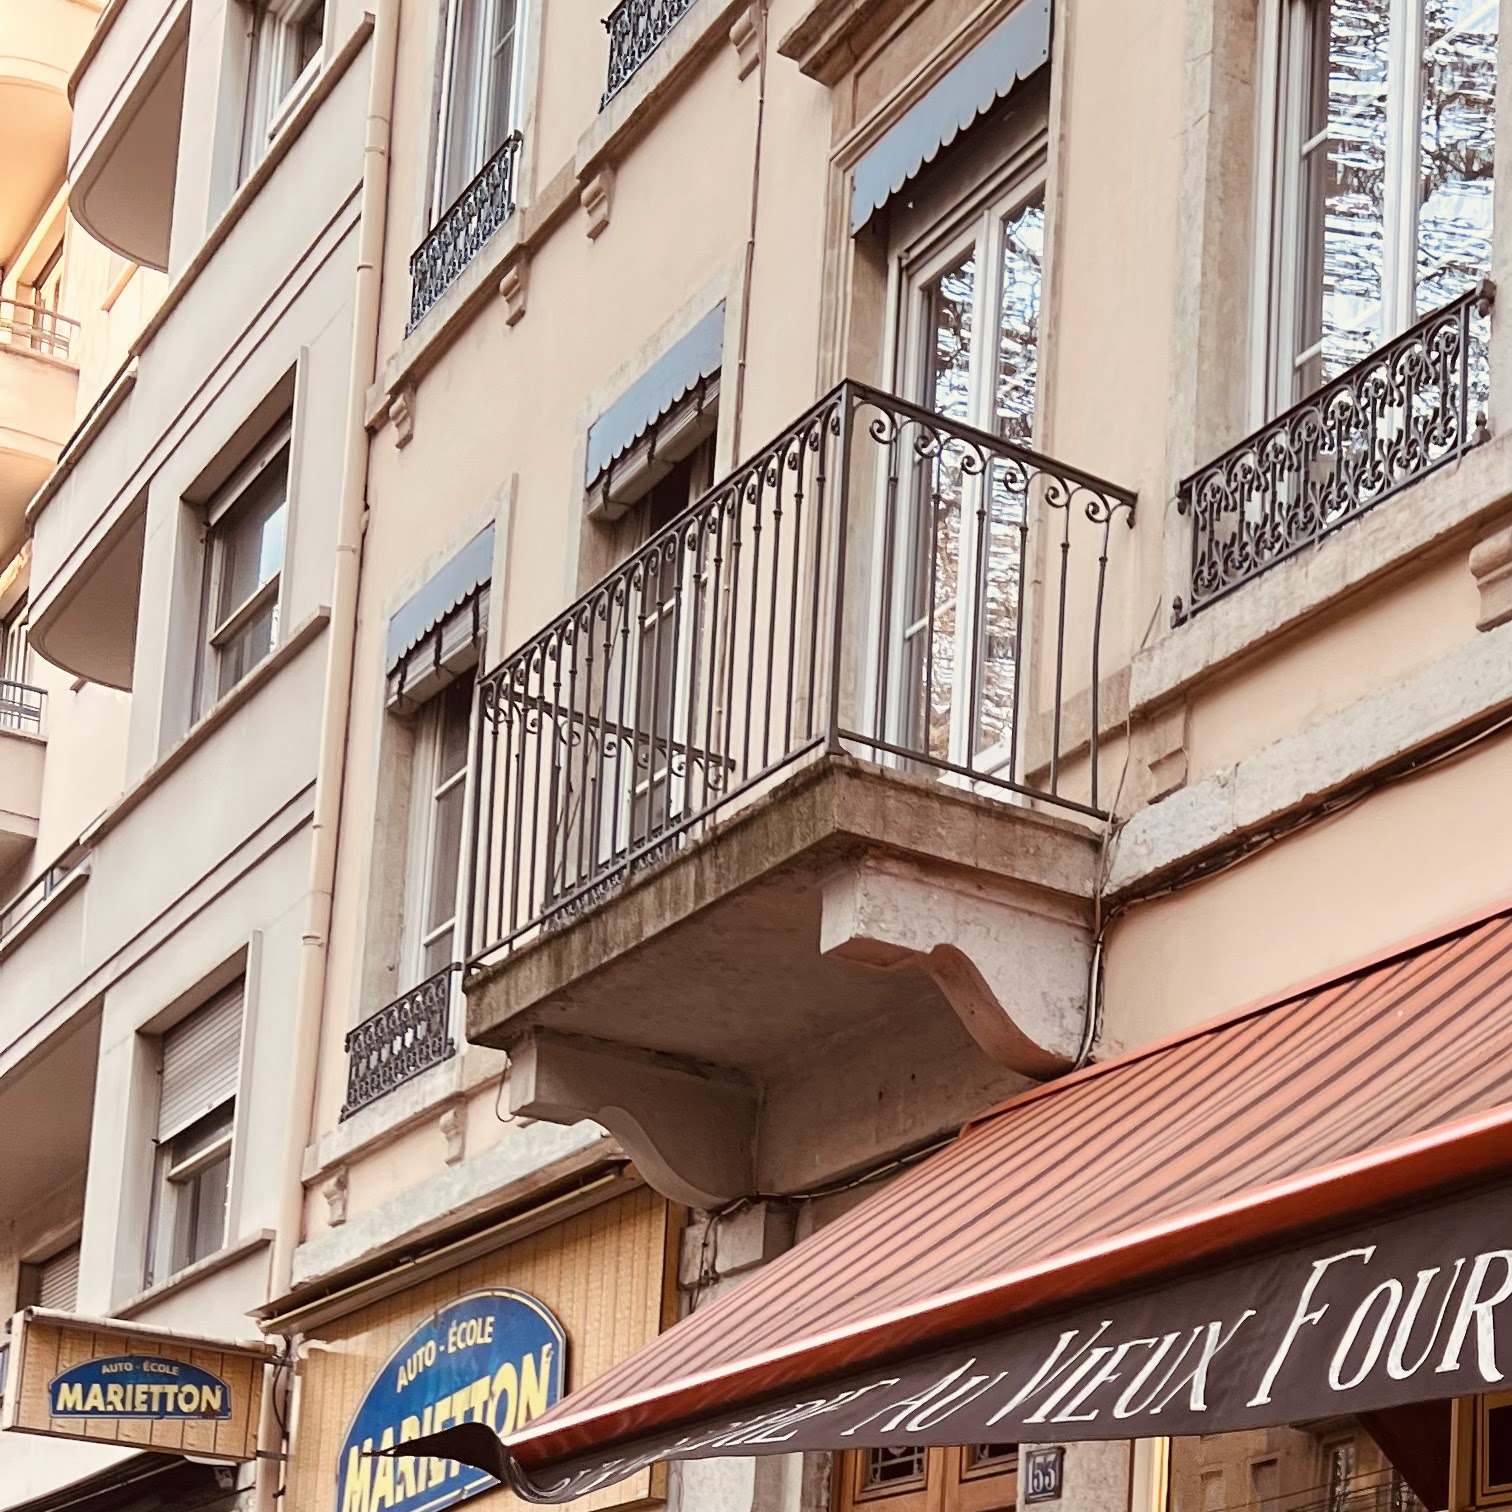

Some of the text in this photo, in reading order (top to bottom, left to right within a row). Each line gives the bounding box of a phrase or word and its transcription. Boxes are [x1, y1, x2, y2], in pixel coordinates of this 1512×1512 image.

[101, 1362, 133, 1375] AUTO
[143, 1360, 180, 1375] ÉCOLE
[397, 1340, 437, 1393] AUTO
[448, 1315, 495, 1354] ÉCOLE
[840, 1357, 1008, 1437] AU
[986, 1309, 1257, 1426] VIEUX
[56, 1382, 223, 1413] MARIETTON
[1028, 1453, 1057, 1494] 153
